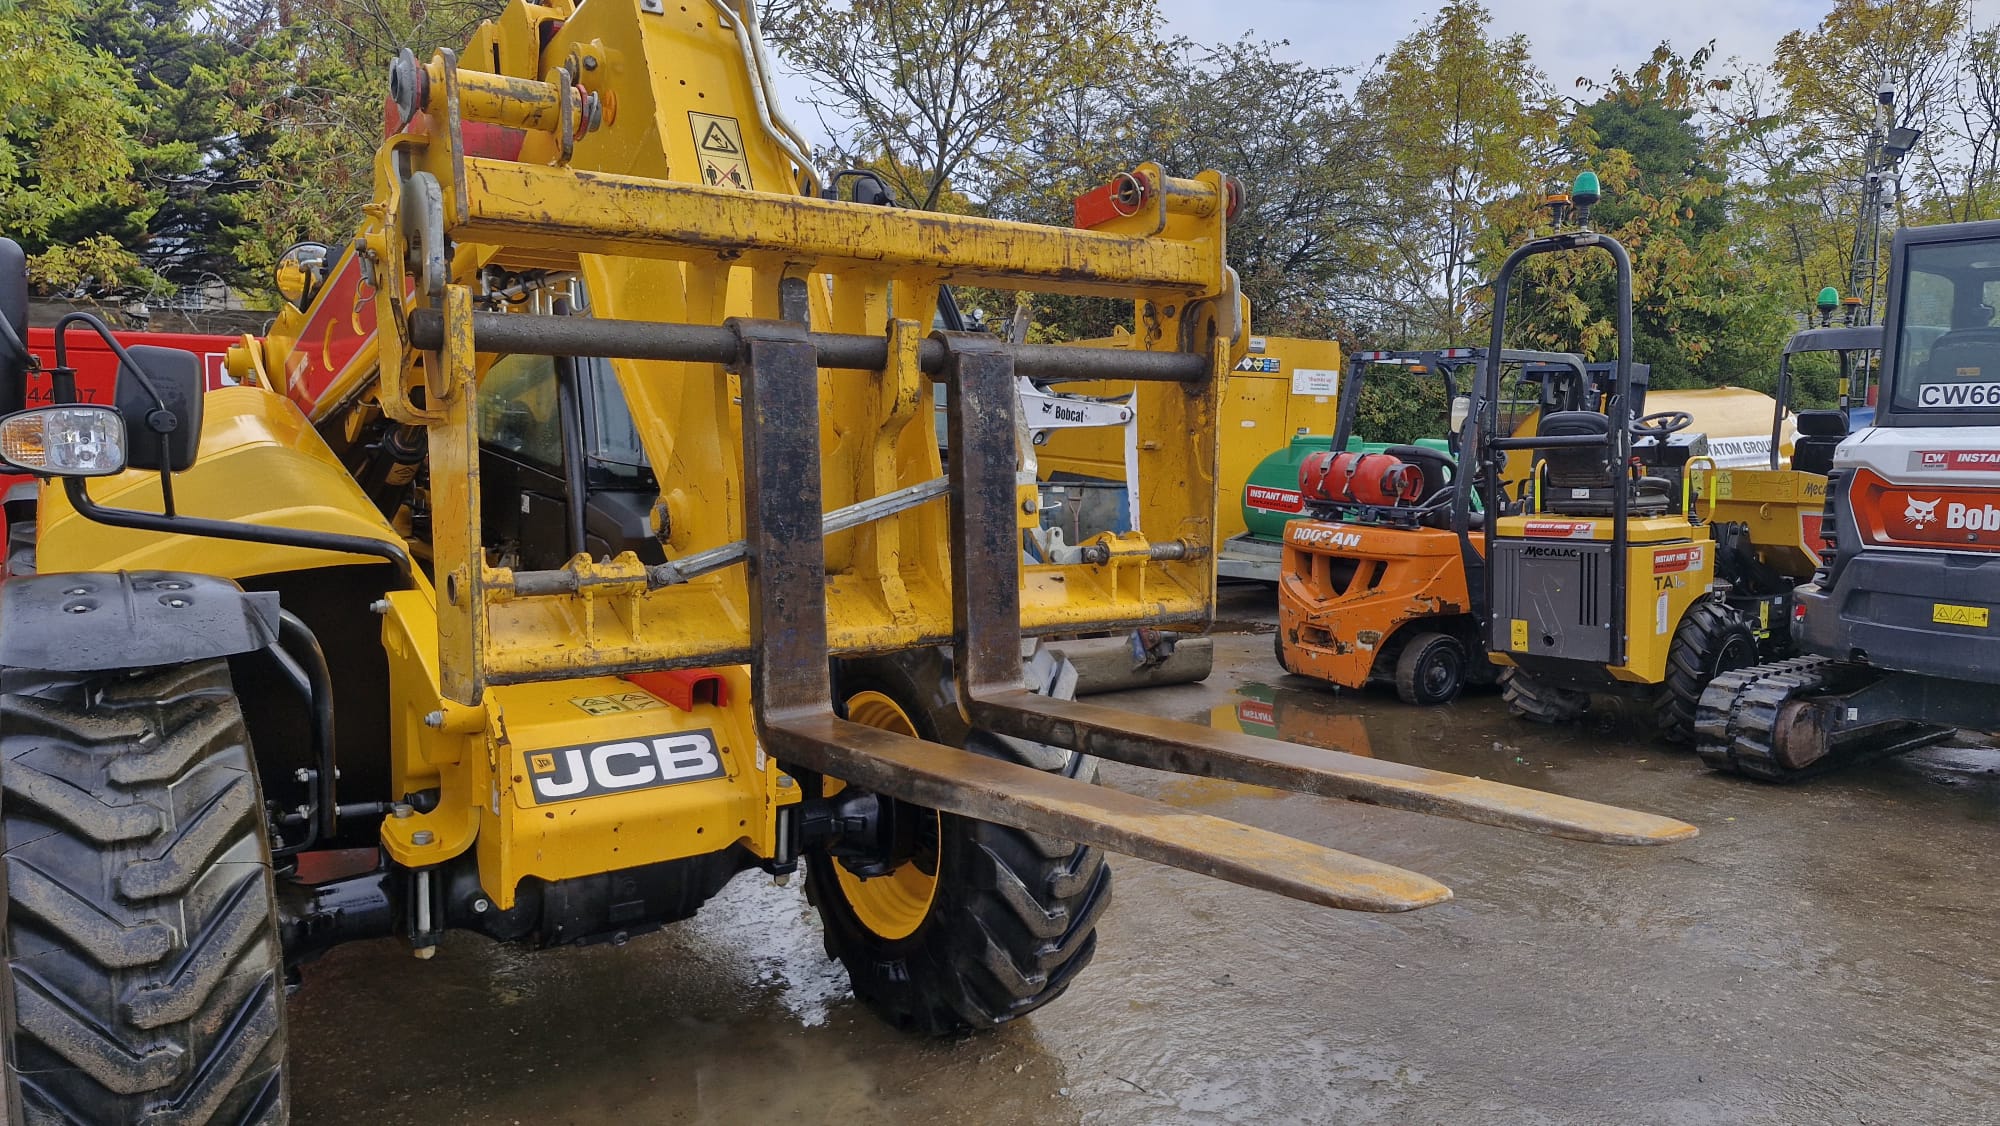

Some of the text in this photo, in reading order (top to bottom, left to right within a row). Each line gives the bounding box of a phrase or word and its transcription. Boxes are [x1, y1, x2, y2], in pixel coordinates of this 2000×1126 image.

[1922, 385, 2000, 405] CW66
[1055, 405, 1084, 423] Bobcat
[1924, 453, 1945, 463] CW
[1250, 489, 1299, 504] INSTANT HIRE
[1946, 502, 2000, 531] Bob
[1293, 527, 1362, 547] DOOSAN
[536, 734, 719, 796] JCB
